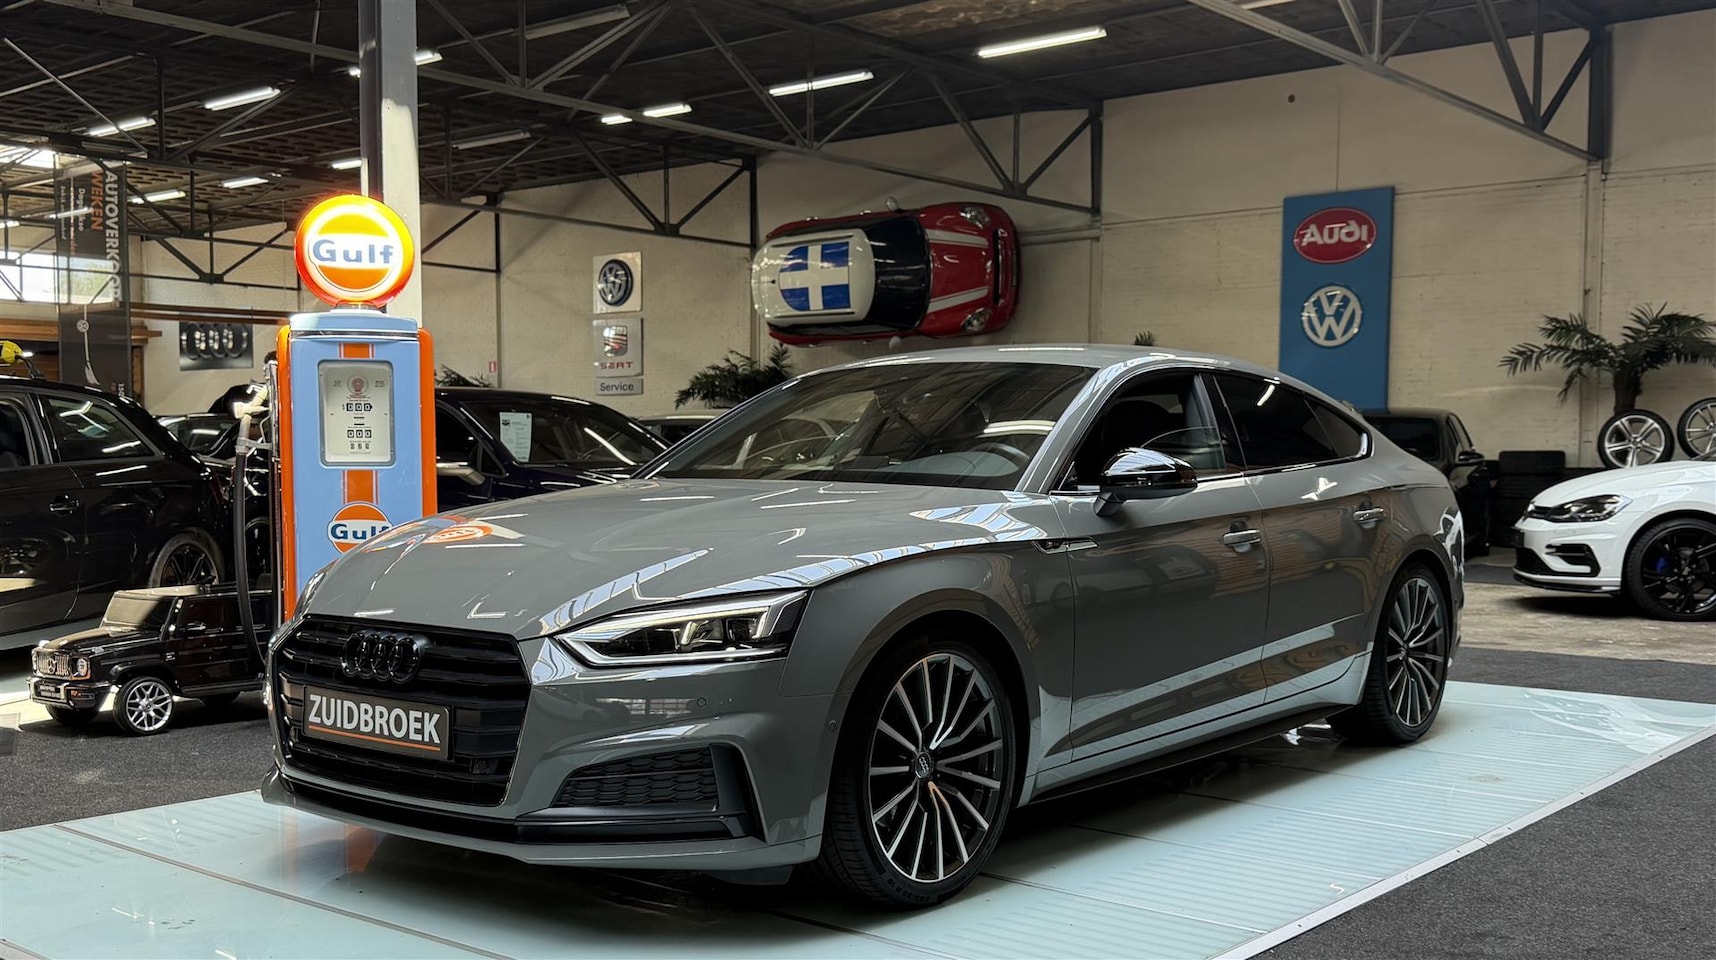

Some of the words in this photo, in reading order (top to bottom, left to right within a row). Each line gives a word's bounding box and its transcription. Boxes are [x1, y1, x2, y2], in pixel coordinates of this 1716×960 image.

[92, 171, 103, 230] WEKEN
[312, 238, 394, 265] Gulf
[600, 382, 634, 392] Service
[308, 694, 441, 744] ZUIDBROEK
